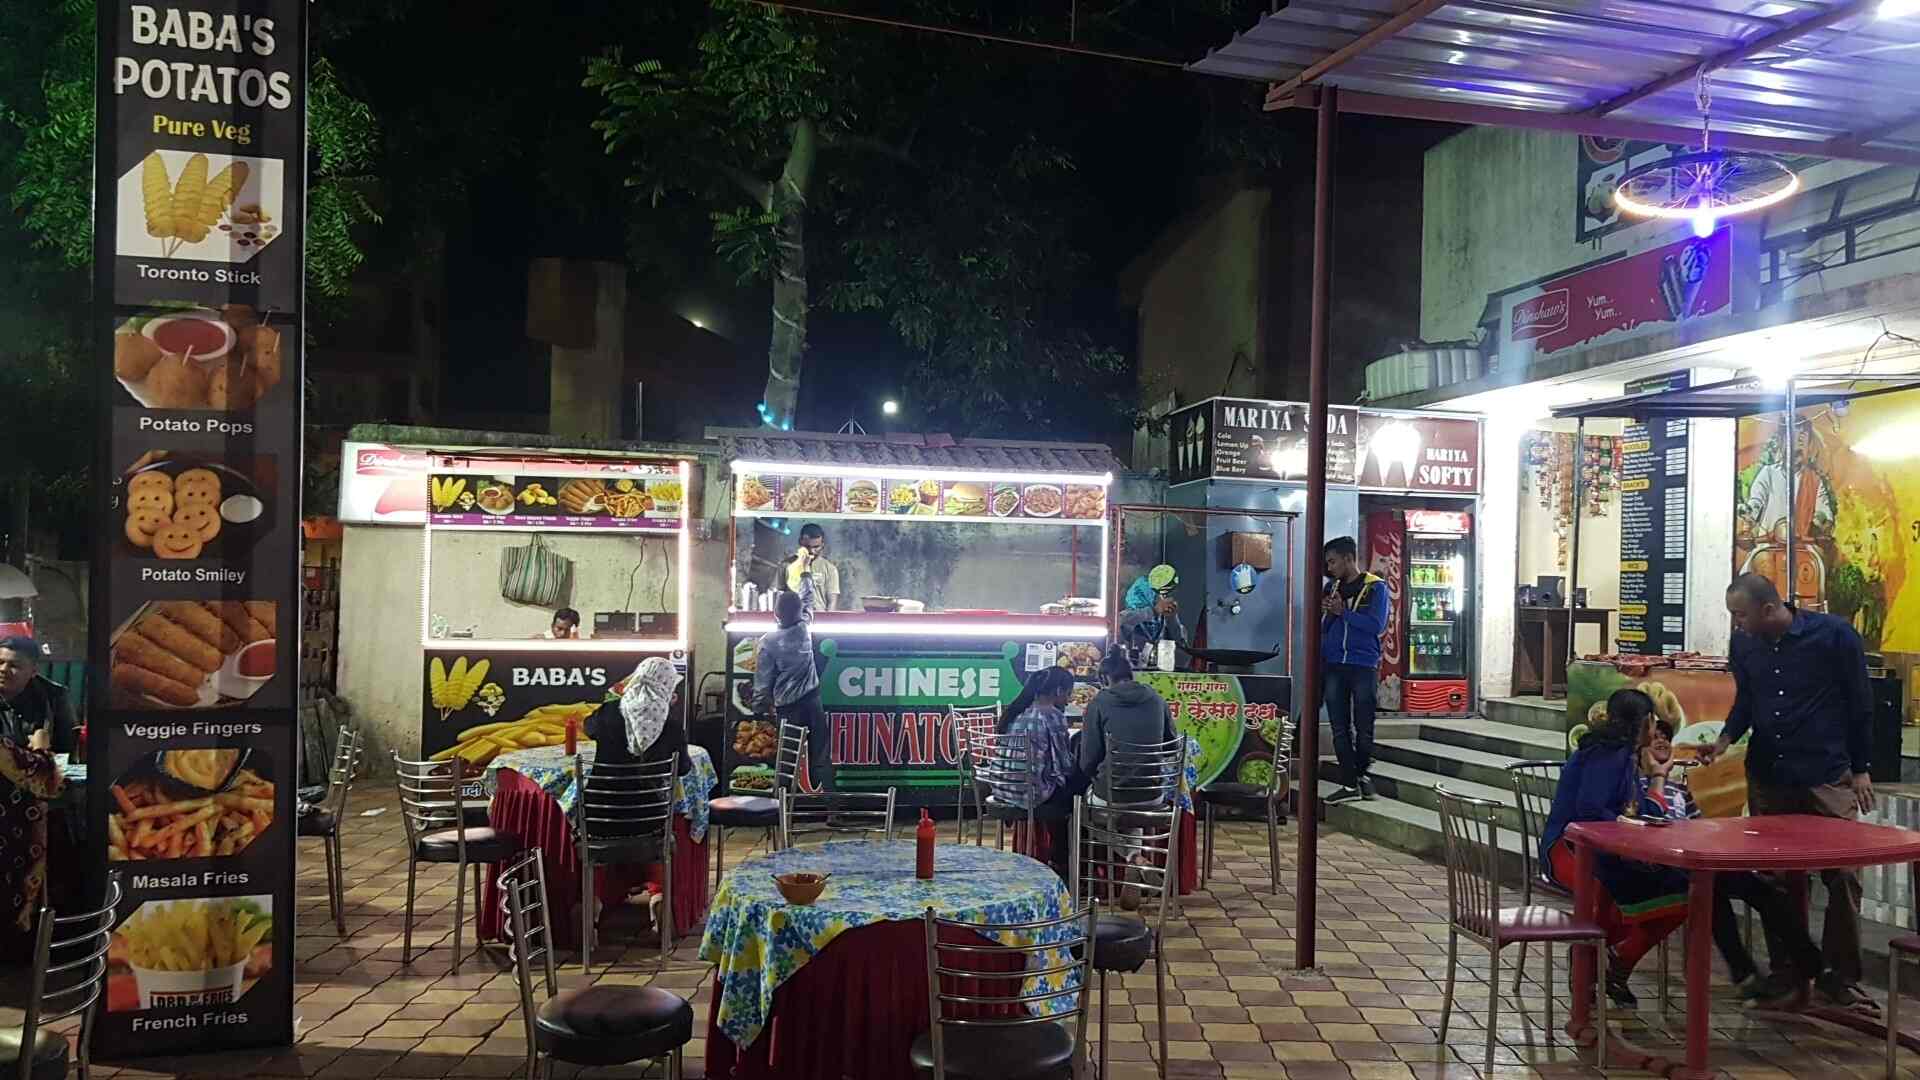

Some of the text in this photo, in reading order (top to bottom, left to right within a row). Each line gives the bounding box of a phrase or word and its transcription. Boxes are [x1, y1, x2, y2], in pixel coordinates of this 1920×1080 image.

[131, 5, 275, 55] BABA'S
[114, 56, 291, 110] POTATOS
[153, 114, 251, 144] Pure Veg
[137, 265, 261, 285] Toronto Stick
[139, 417, 253, 436] Potato Pops
[1224, 406, 1348, 435] MARIYA SDA
[1426, 447, 1468, 462] MARIYA
[1419, 464, 1474, 487] SOFTY
[142, 568, 246, 585] Potato Smiley
[512, 667, 607, 686] BABA'S
[838, 666, 1000, 698] CHINESE
[124, 722, 262, 739] Veggie Fingers
[132, 872, 249, 889] Masala Fries
[132, 1011, 248, 1032] French Fries
